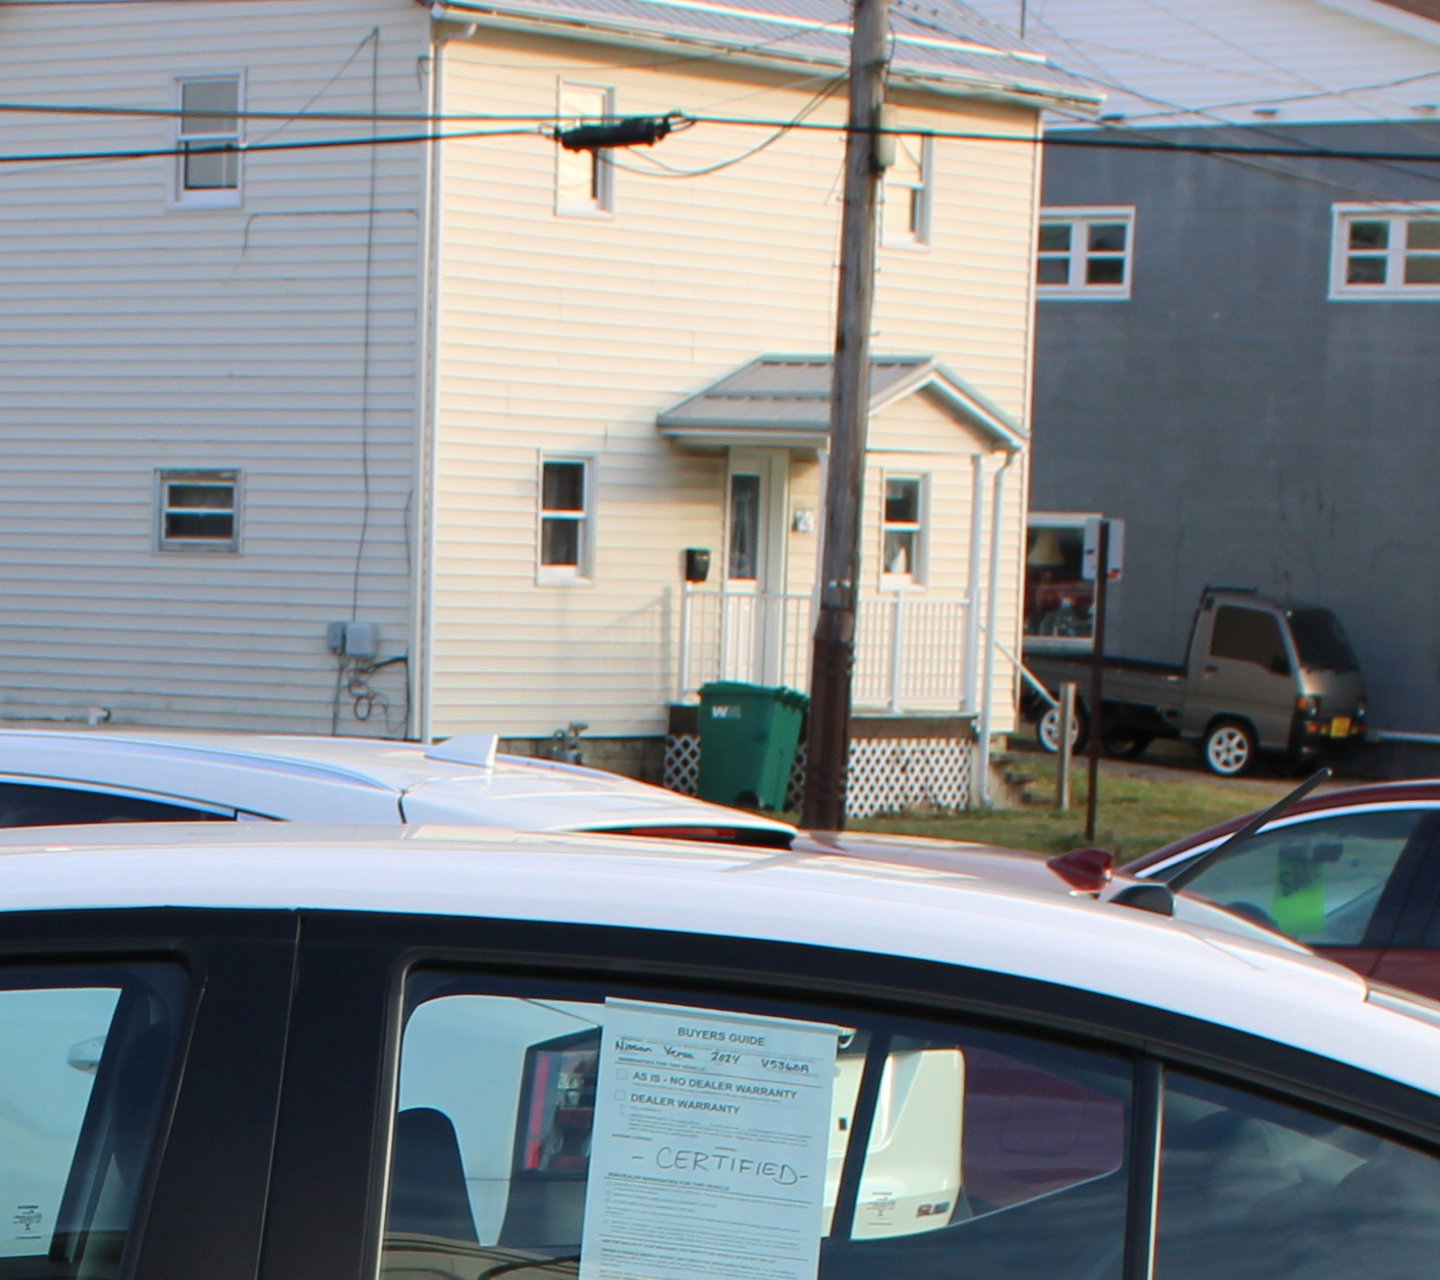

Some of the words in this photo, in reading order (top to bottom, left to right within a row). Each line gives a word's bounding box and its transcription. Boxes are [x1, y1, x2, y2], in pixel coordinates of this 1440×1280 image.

[677, 1026, 726, 1042] BUYERS
[729, 1033, 766, 1047] GUIDE
[711, 1051, 741, 1065] 2024
[632, 1072, 647, 1082] AS
[650, 1074, 661, 1083] IS
[670, 1076, 686, 1087] NO
[688, 1079, 733, 1092] DEALER
[735, 1084, 798, 1100] WARRANTY
[630, 1093, 675, 1107] DEALER
[677, 1099, 741, 1115] WARRANTY
